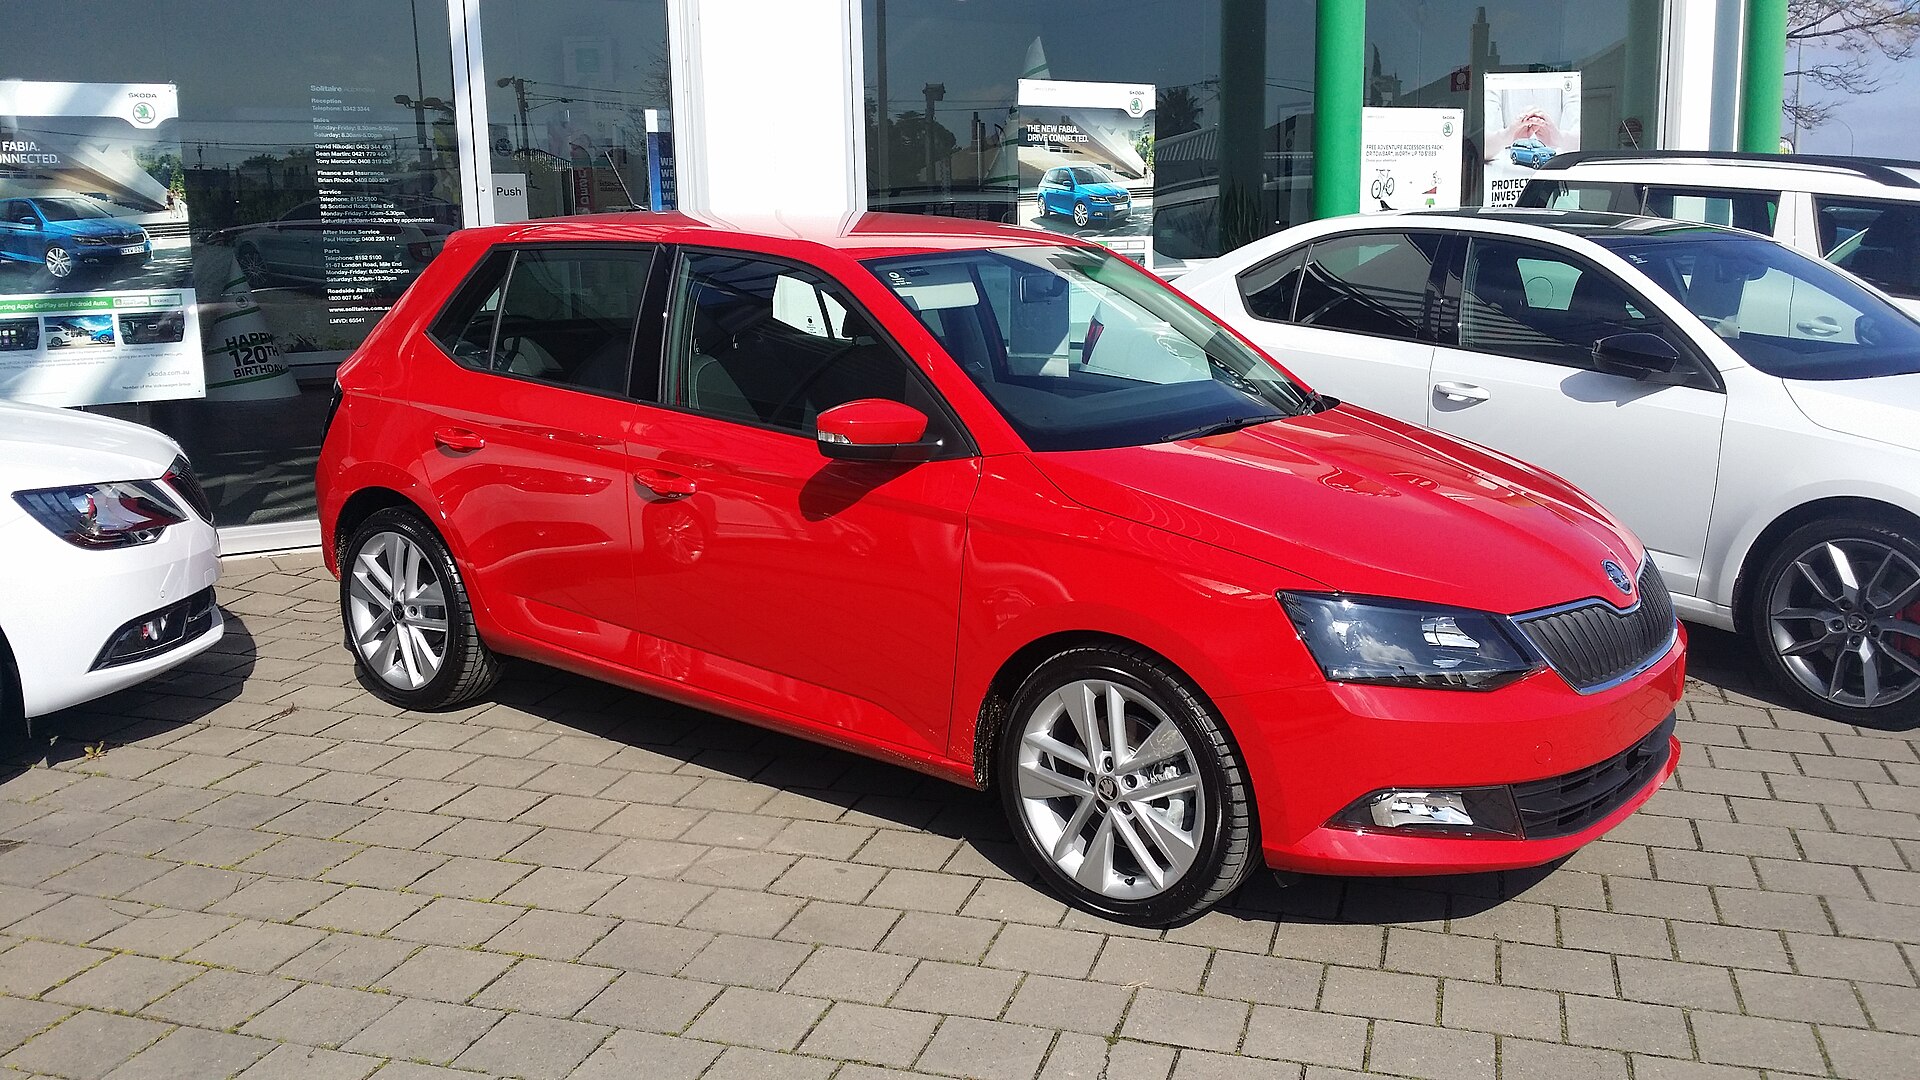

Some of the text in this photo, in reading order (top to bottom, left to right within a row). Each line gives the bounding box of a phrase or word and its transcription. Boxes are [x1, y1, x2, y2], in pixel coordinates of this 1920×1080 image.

[1027, 124, 1040, 132] THE
[1027, 134, 1089, 143] DRIVE CONNECTED.
[2, 141, 41, 152] FABIA.
[0, 154, 60, 164] NNECTED.
[496, 186, 522, 196] Push
[224, 332, 274, 348] HAPPY
[228, 346, 279, 367] 120TH
[233, 364, 283, 378] BIRTHDAY
